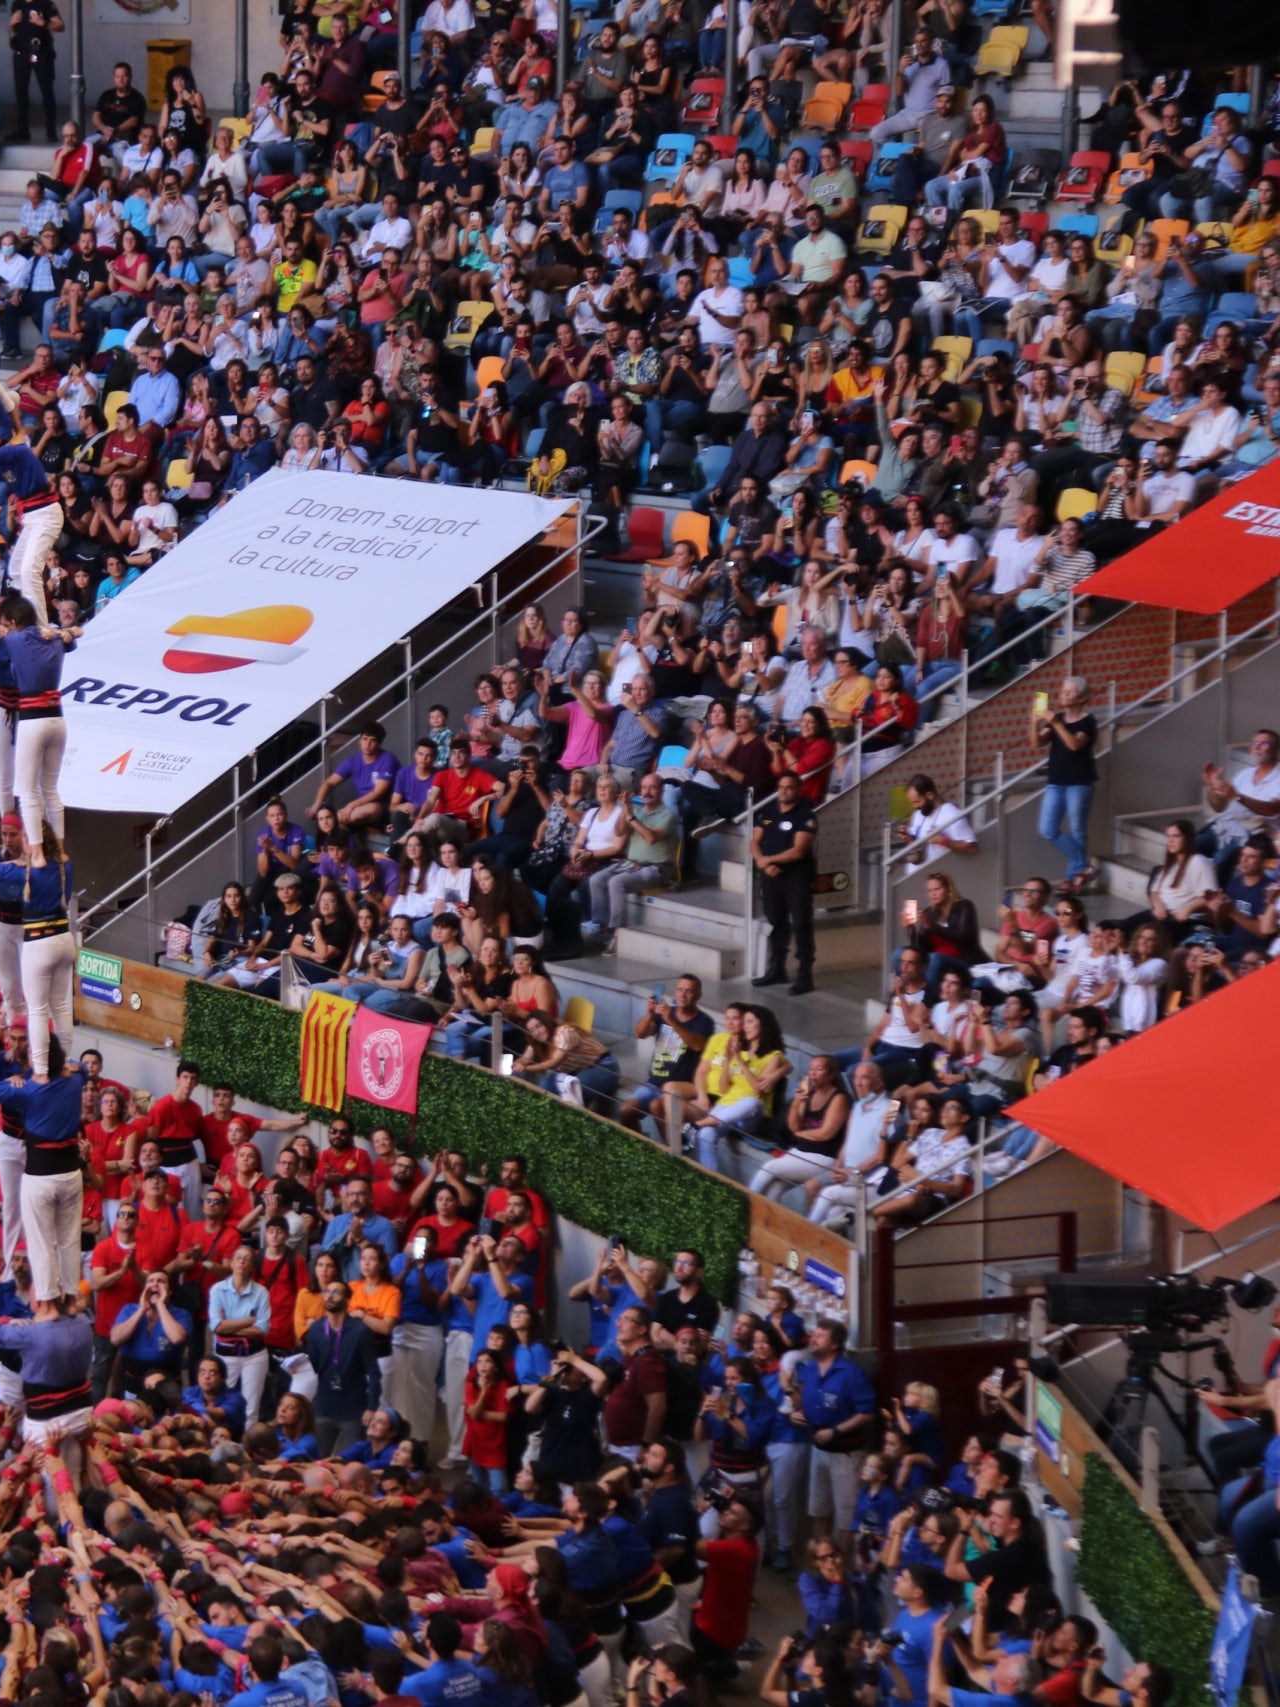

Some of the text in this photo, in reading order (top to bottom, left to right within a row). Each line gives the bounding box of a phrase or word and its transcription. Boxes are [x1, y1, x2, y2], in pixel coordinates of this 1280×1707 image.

[285, 497, 481, 537] Donem suport
[257, 524, 438, 561] a la tradició i
[228, 545, 359, 581] la cultura
[60, 676, 252, 726] REPSOL
[138, 759, 186, 772] CASTELLS
[145, 751, 193, 764] CONCURS
[81, 955, 119, 981] SORTIDA
